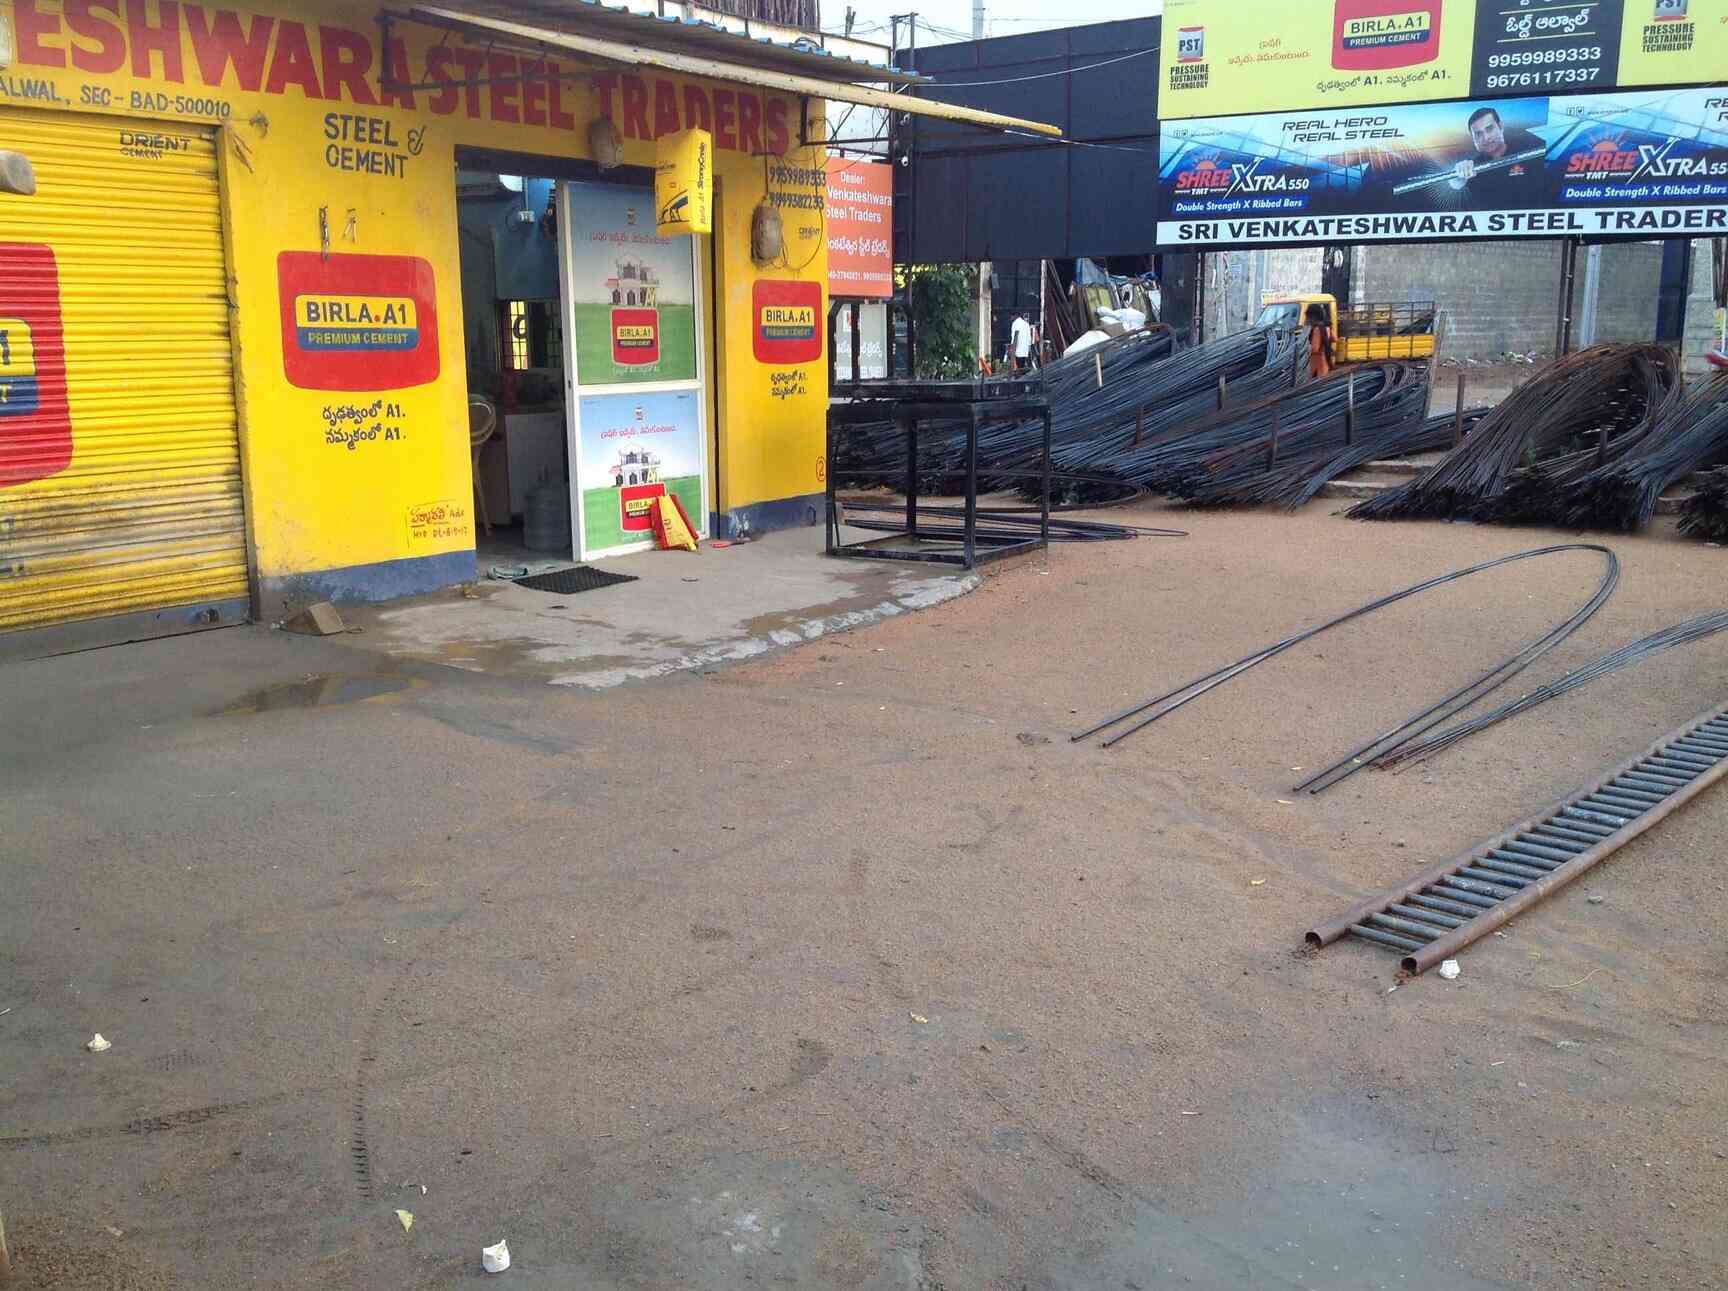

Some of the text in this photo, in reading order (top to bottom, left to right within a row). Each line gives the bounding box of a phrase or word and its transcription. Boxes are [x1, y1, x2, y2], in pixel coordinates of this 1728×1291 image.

[1643, 23, 1695, 35] PRESSURE
[1179, 38, 1200, 51] PST
[1350, 33, 1422, 46] PREMIUM CEMENT
[1642, 33, 1694, 44] SUSTAINING
[1642, 42, 1693, 53] TECHNOLOGY
[1488, 47, 1601, 68] 9959989333
[1170, 64, 1209, 75] PRESSURE
[1170, 73, 1209, 83] SUSTAINING
[1487, 68, 1600, 89] 9676117337
[427, 47, 576, 131] STEEL
[1170, 81, 1208, 91] TECHNOLOGY
[325, 112, 398, 147] STEEL
[1282, 116, 1387, 131] REAL HERO
[1293, 128, 1405, 143] REAL STEEL
[326, 144, 408, 179] CEMENT
[1567, 151, 1638, 172] SHREE
[1176, 169, 1232, 188] SHREE
[1288, 178, 1310, 190] 550
[1586, 172, 1609, 180] TMT
[1192, 187, 1209, 195] TMT
[1565, 188, 1601, 198] Double
[1605, 187, 1649, 198] Strength
[1663, 184, 1700, 195] Ribbed
[1703, 185, 1727, 195] Bars
[1175, 202, 1204, 212] Double
[1206, 200, 1241, 212] Strength
[1252, 198, 1281, 208] Ribbed
[1283, 198, 1302, 207] Bars
[1178, 209, 1728, 240] SRI VENKATESHWARA STEEL TRADER
[308, 332, 408, 345] PREMIUM CEMENT
